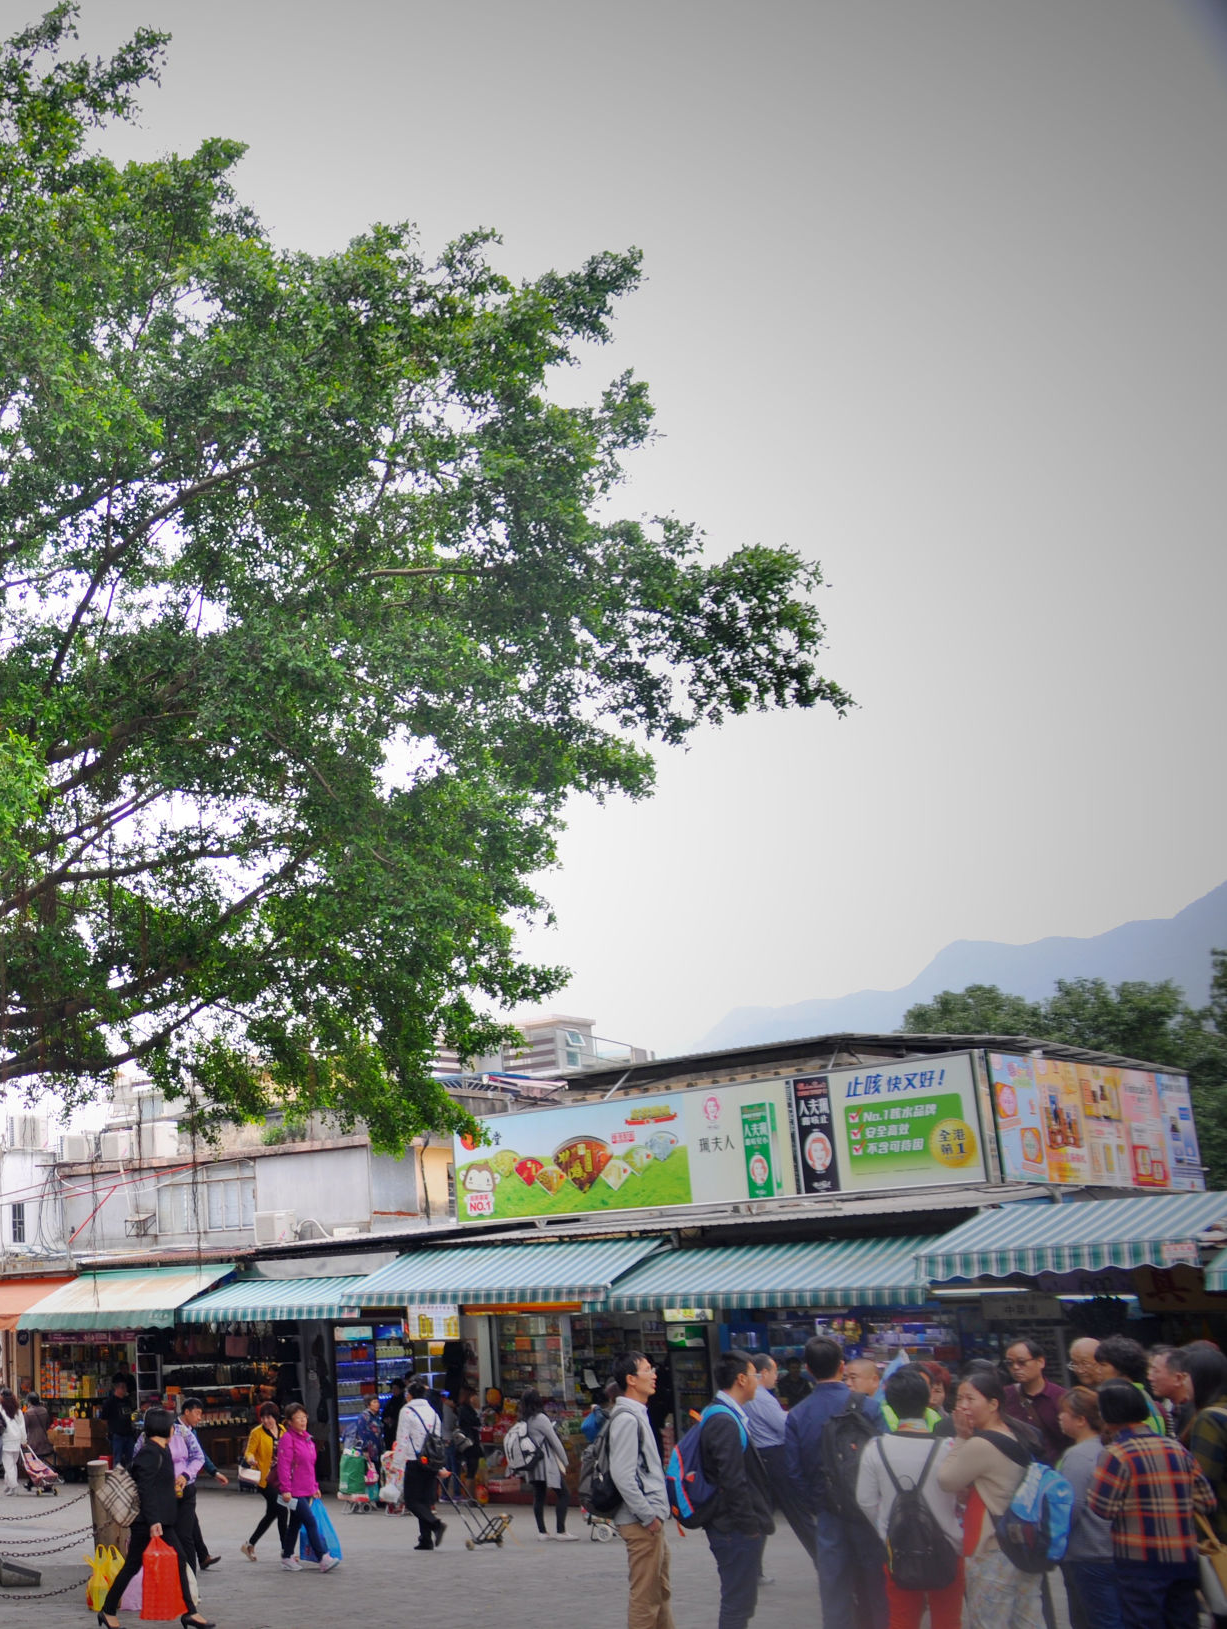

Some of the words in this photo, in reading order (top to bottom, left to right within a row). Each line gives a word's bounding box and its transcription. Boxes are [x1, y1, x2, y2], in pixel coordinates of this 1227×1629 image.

[845, 1074, 883, 1098] 止咳
[938, 1128, 966, 1142] 全港
[469, 1201, 491, 1211] NO.1
